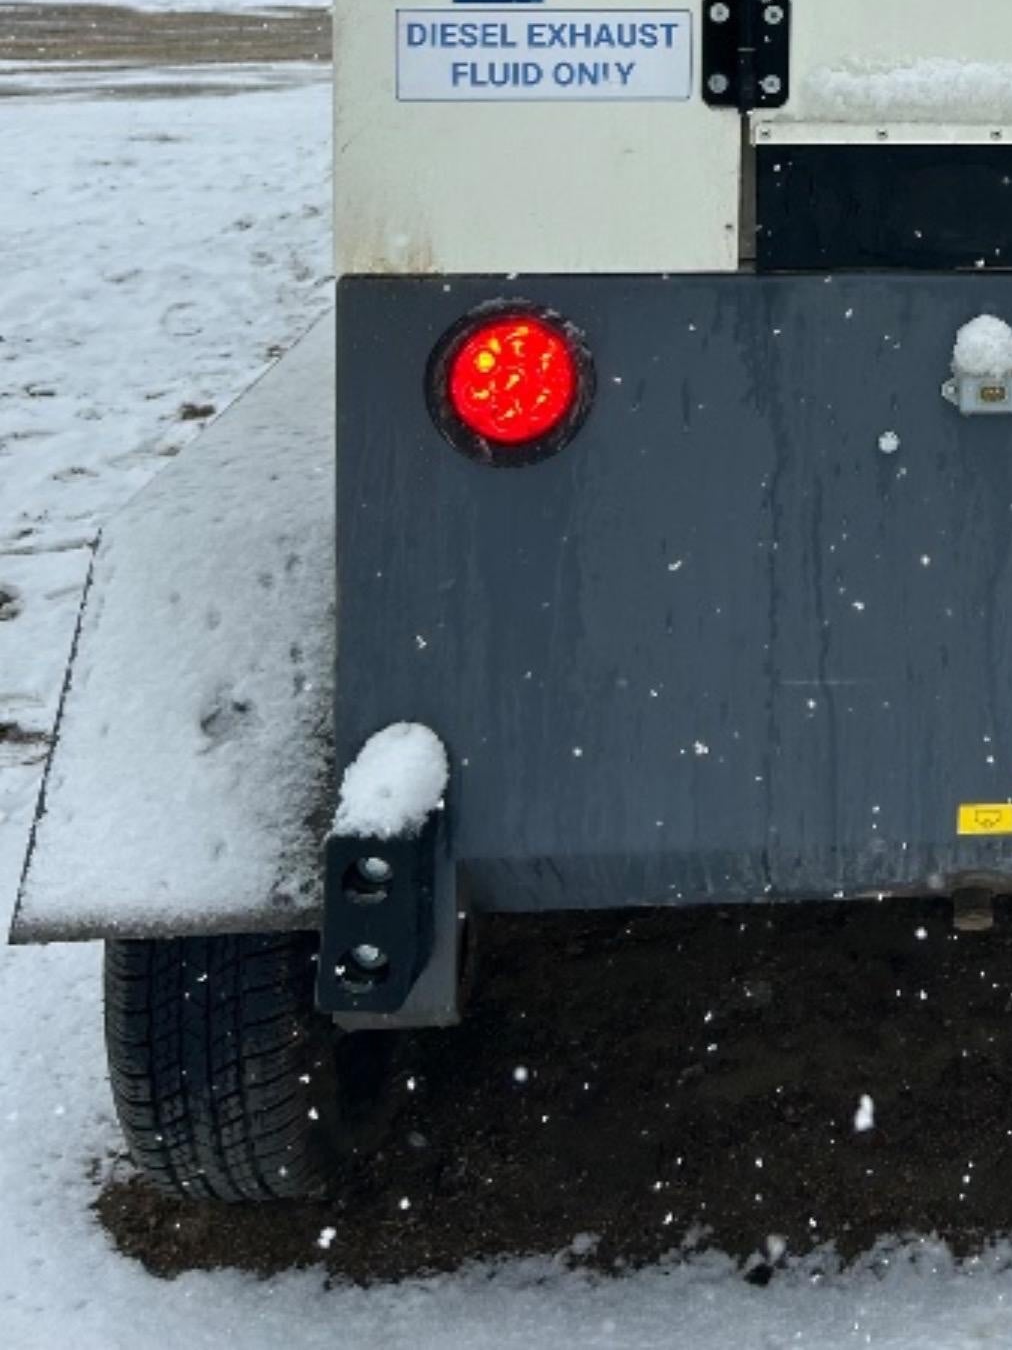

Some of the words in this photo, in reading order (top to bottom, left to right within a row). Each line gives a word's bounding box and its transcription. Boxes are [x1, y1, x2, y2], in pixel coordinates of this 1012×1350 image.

[407, 23, 517, 49] DIESEL
[527, 23, 679, 49] EXHAUST
[452, 62, 544, 87] FLUID
